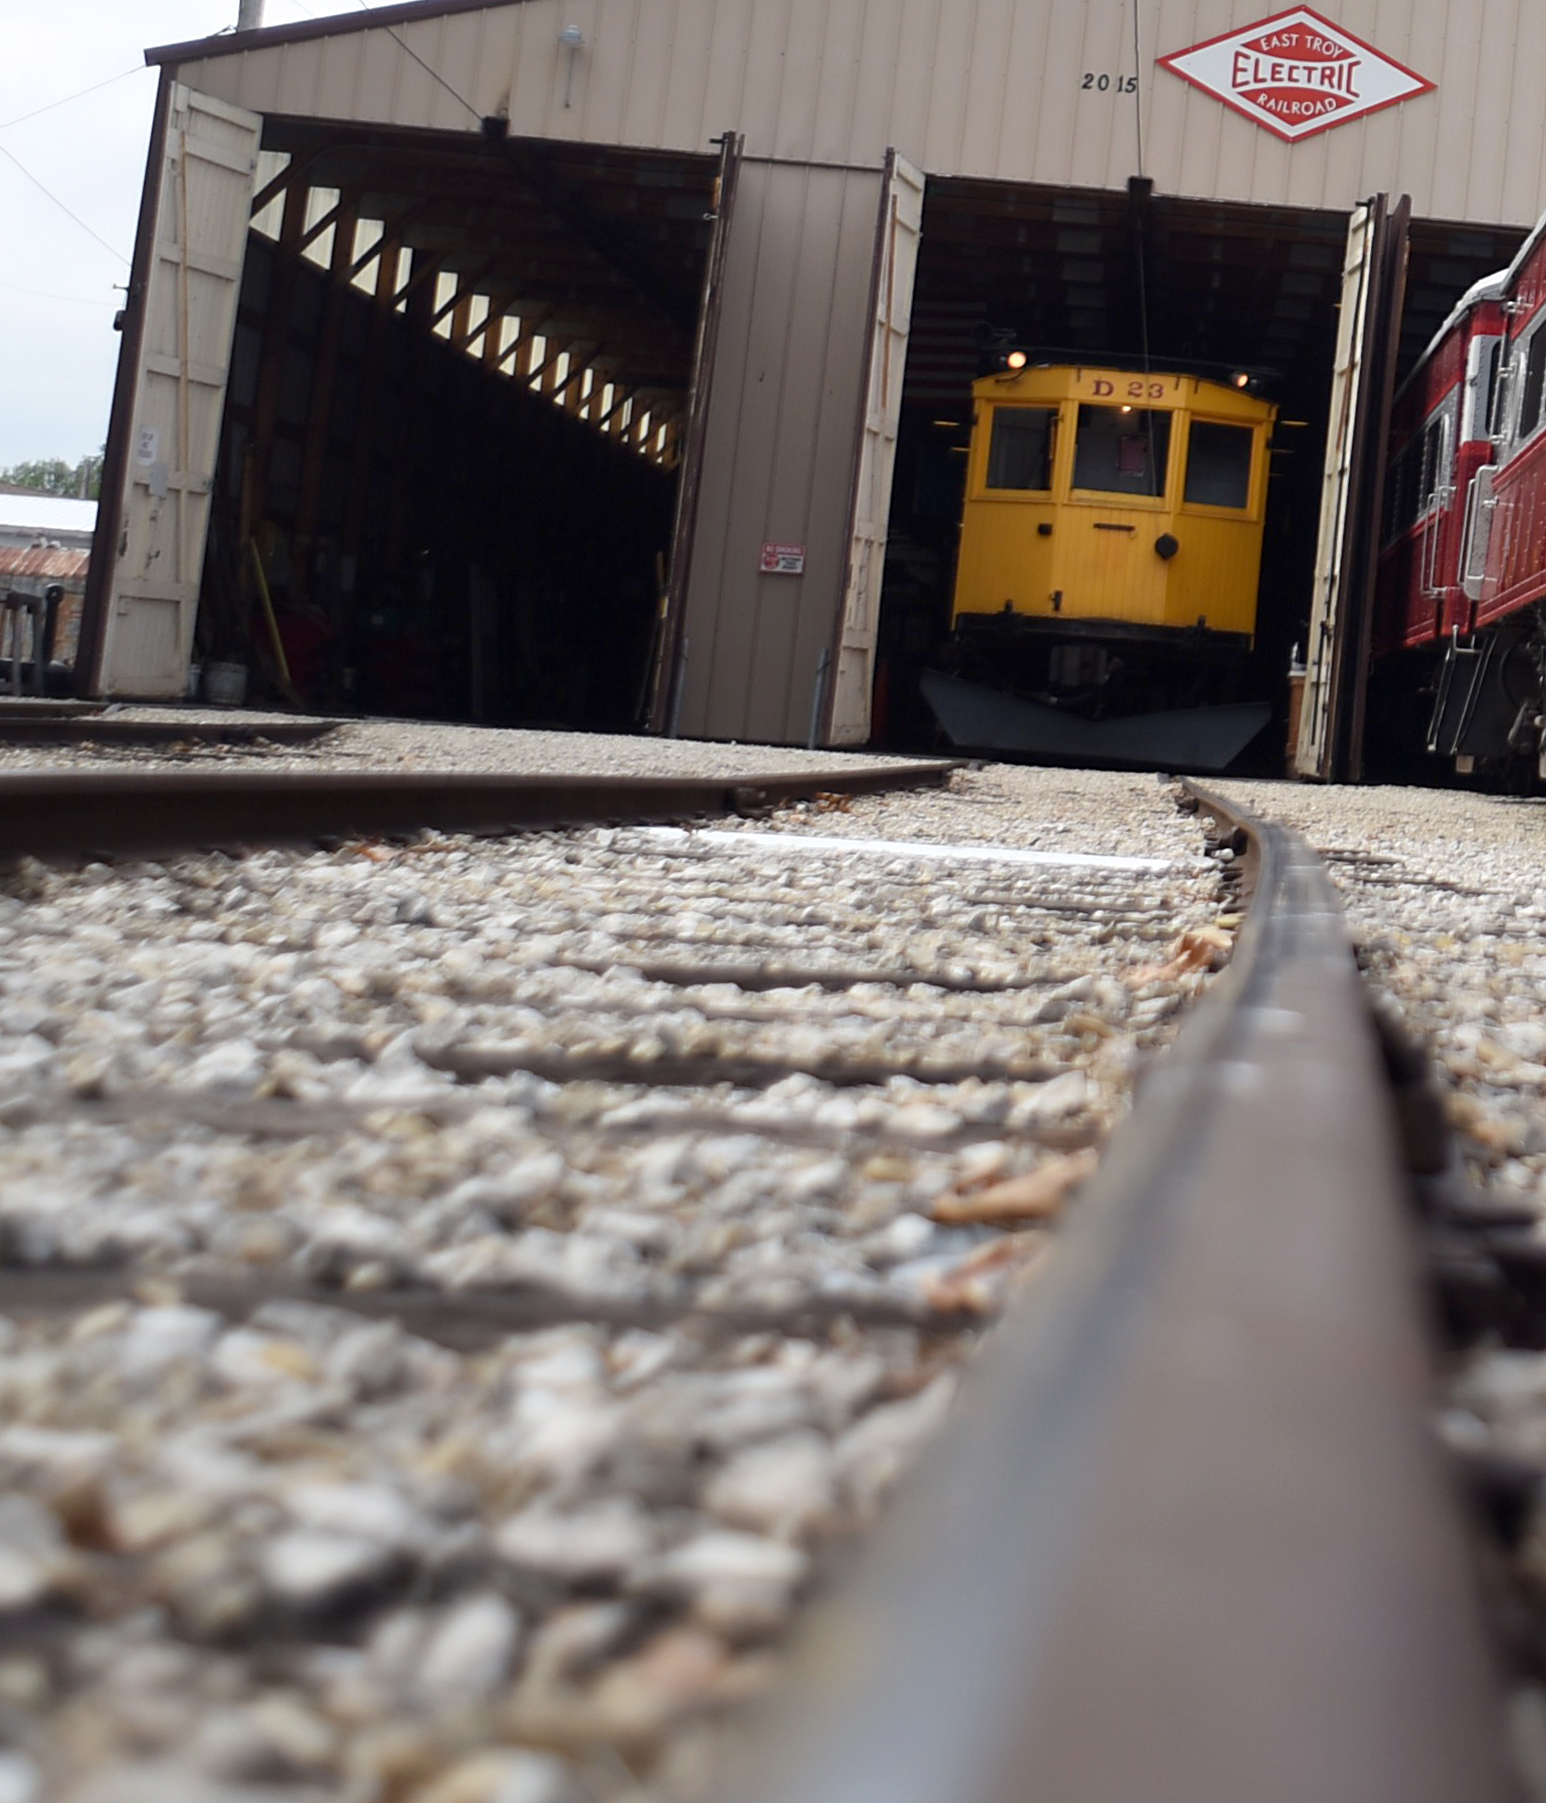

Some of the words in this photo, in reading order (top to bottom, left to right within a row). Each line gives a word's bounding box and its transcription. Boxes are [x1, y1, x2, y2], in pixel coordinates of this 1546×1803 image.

[1260, 33, 1300, 51] EAST
[1304, 35, 1344, 58] TROY
[1081, 72, 1138, 94] 2015
[1231, 50, 1362, 99] ELECTRIC
[1256, 92, 1337, 116] RAILROAD
[1092, 379, 1115, 397] D
[1127, 380, 1164, 399] 23
